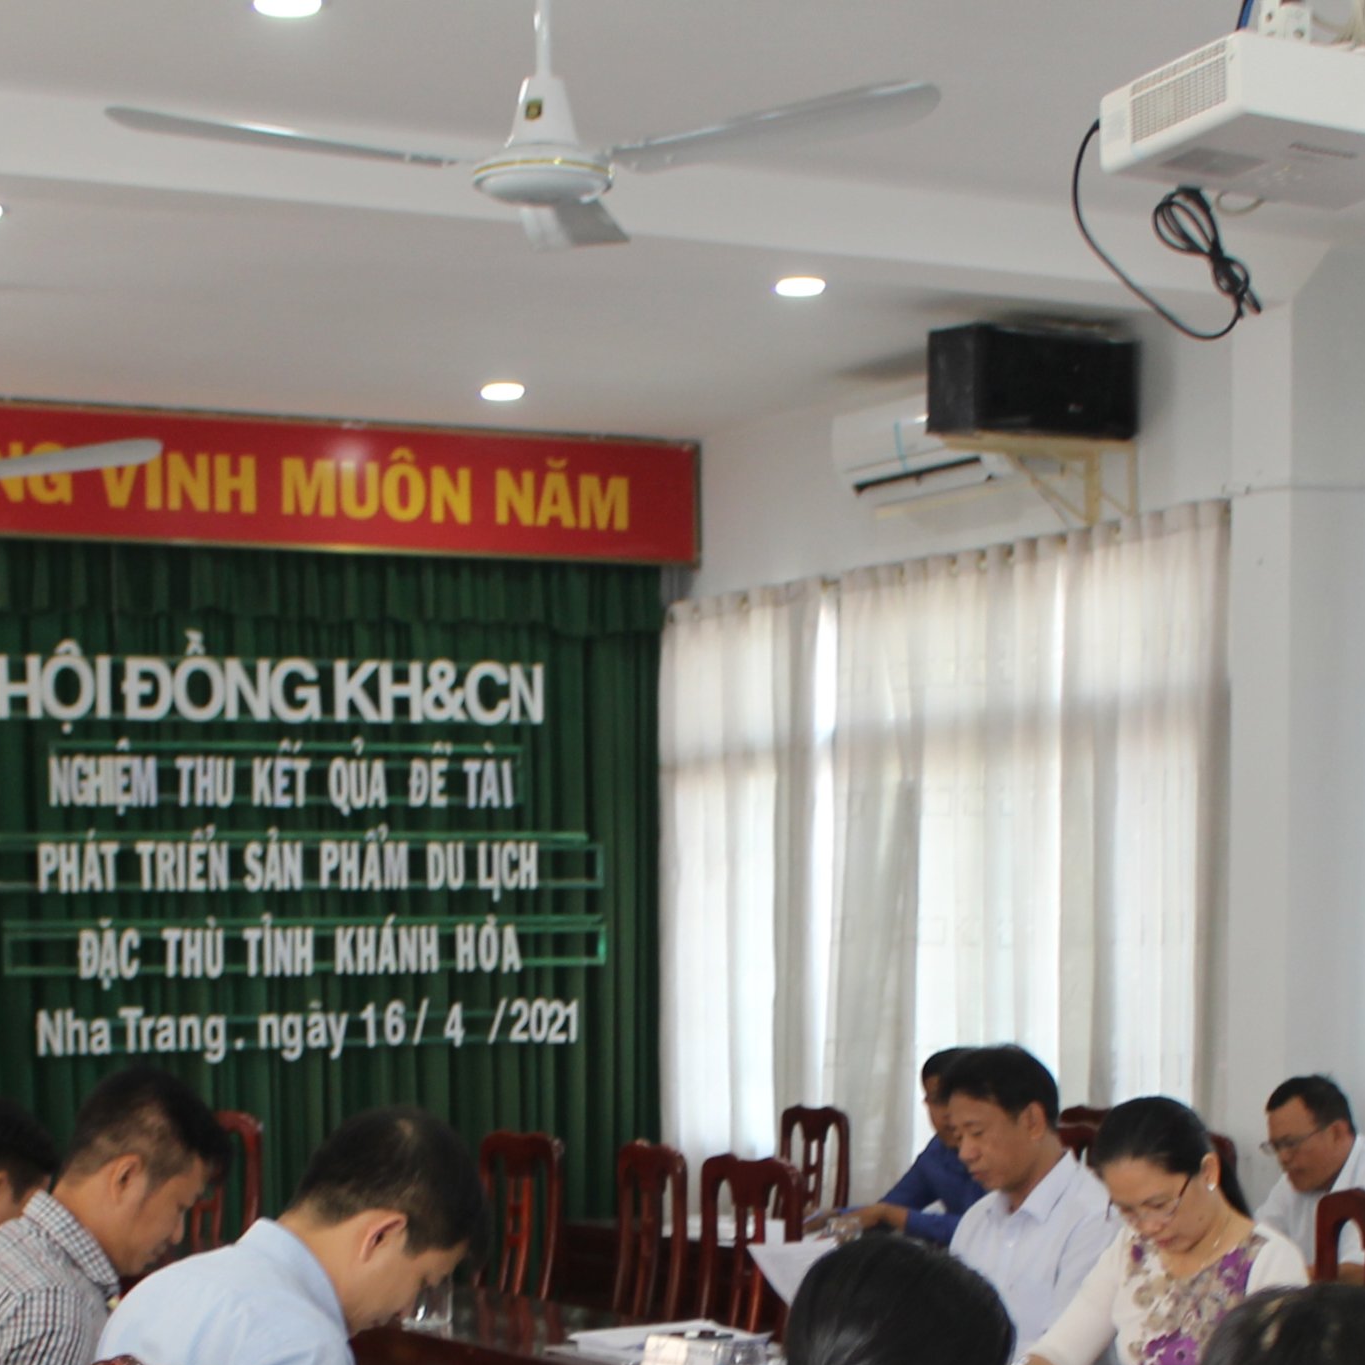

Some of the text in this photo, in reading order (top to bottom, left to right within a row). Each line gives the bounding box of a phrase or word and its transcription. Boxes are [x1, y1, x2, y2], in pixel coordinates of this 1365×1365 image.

[100, 450, 257, 513] VINH
[281, 447, 471, 525] MUÔN
[495, 457, 629, 531] NĂM
[123, 629, 322, 724] ĐỒNG
[336, 658, 544, 725] KH&CN
[48, 736, 514, 817] NGHIỆM THU KẾT QUẢ ĐỀ TÀI
[38, 823, 539, 903] PHÁT TRIỂN SẢN PHẨM DU LỊCH
[78, 917, 141, 990] ĐẶC
[242, 912, 314, 978] TỈNH
[335, 913, 439, 975] KHÁNH
[36, 1008, 111, 1056] Nha
